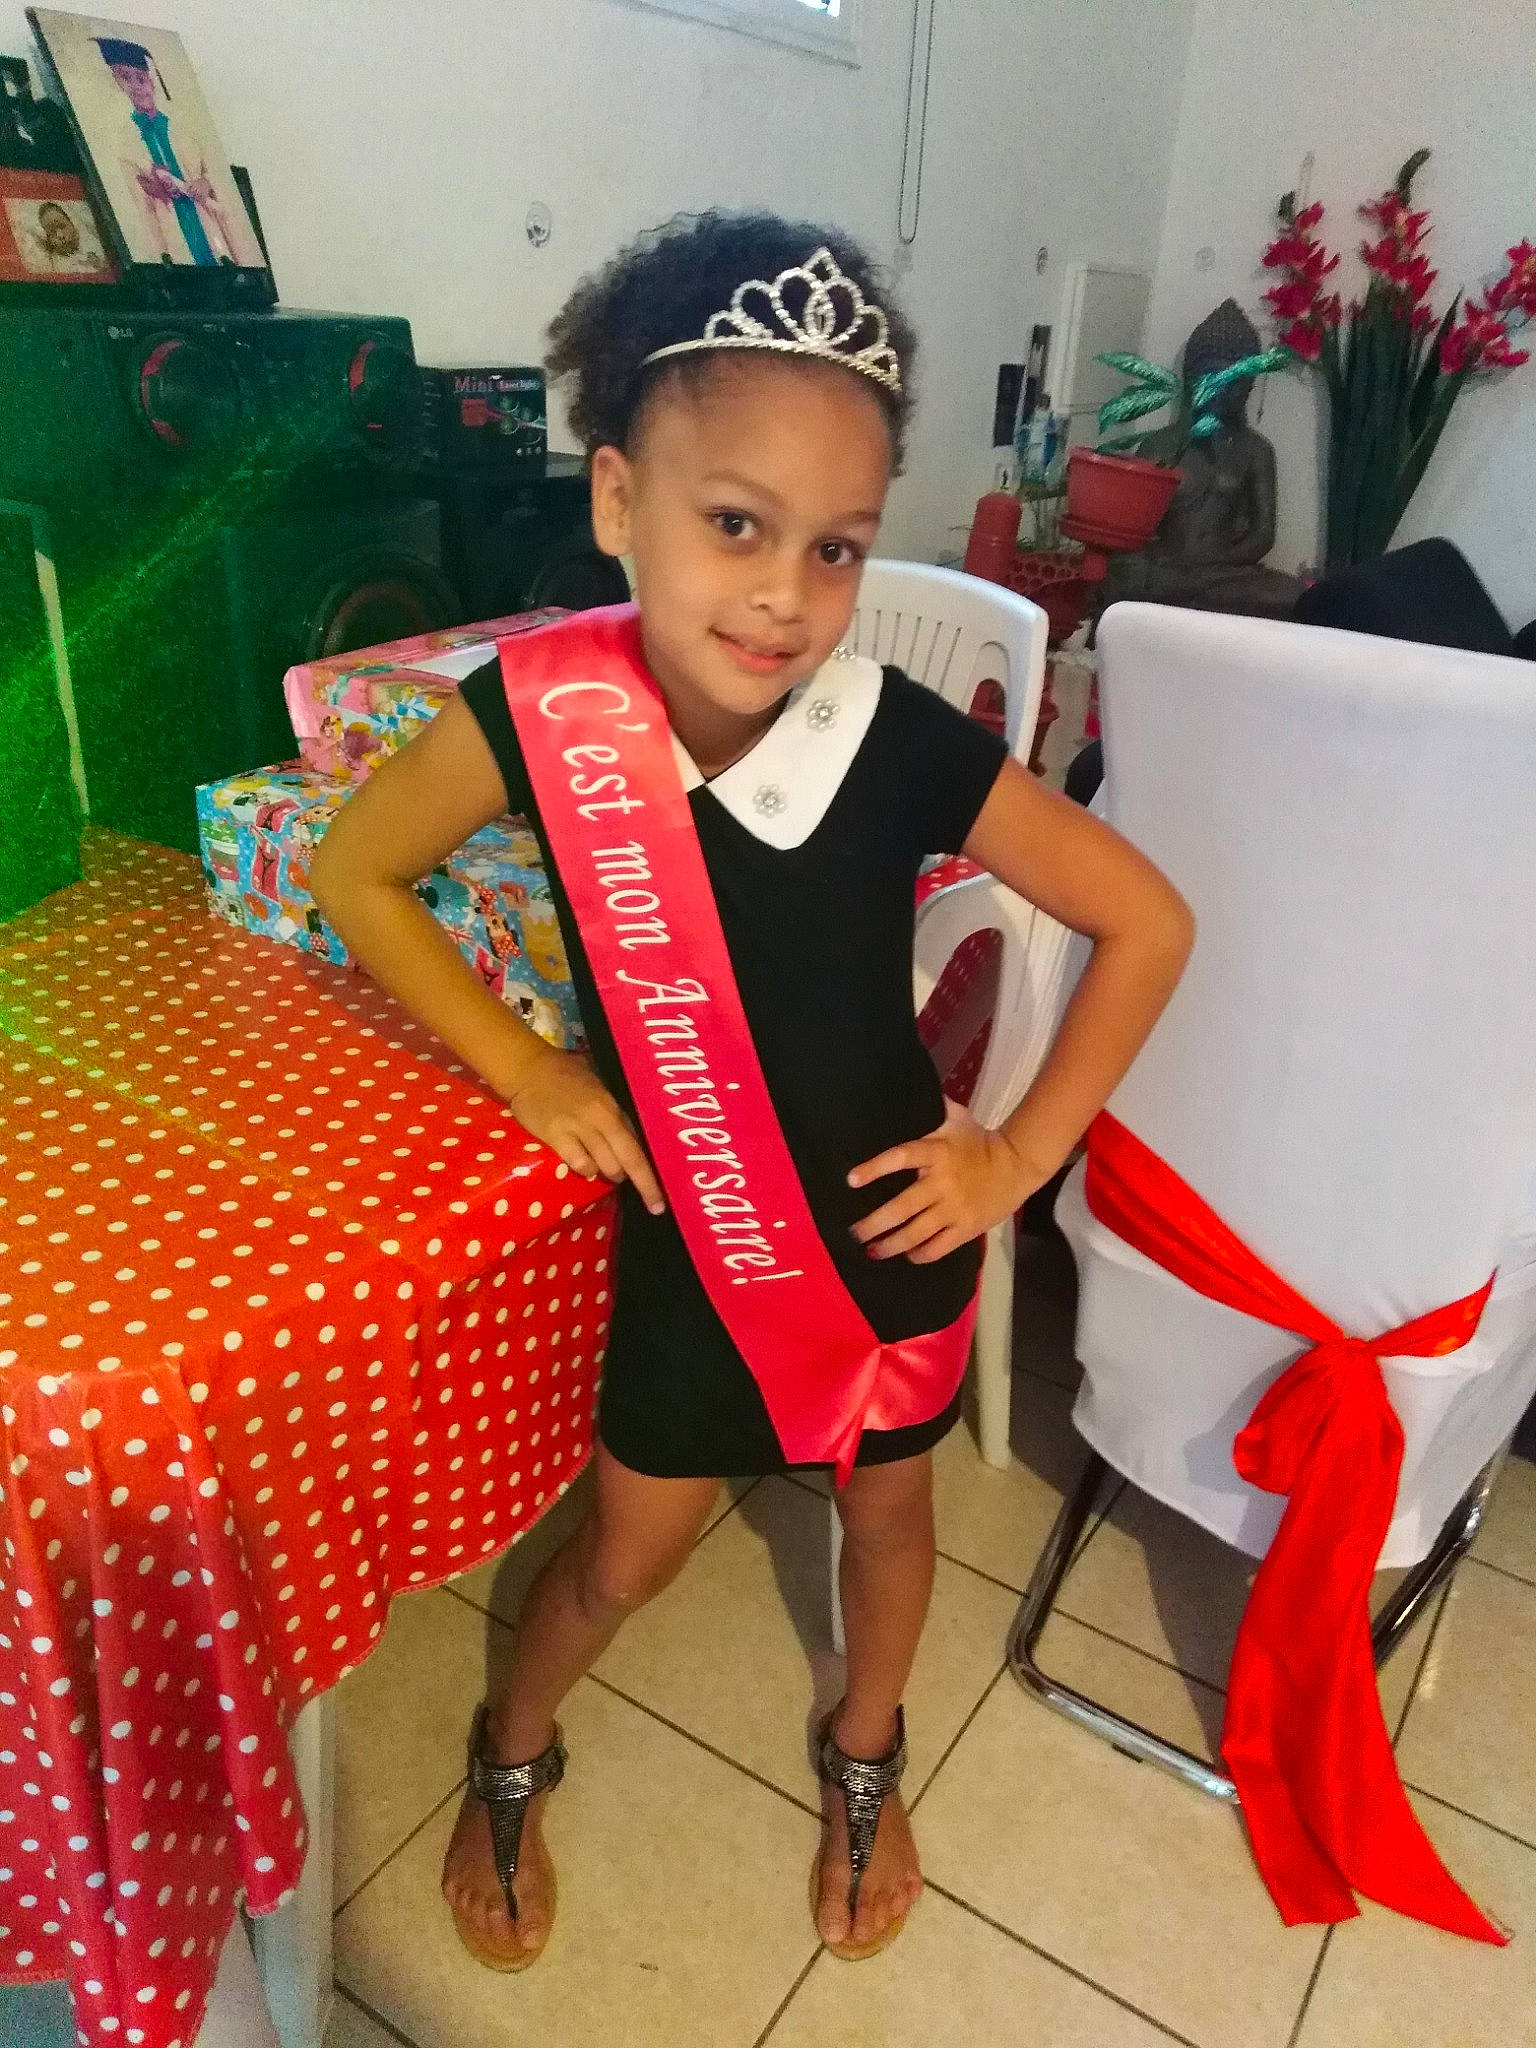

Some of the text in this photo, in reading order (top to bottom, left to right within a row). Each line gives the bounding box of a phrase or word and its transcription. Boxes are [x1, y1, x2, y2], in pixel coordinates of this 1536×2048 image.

[454, 376, 495, 393] Mini
[538, 681, 805, 1287] C'est mon Anniversaire!
